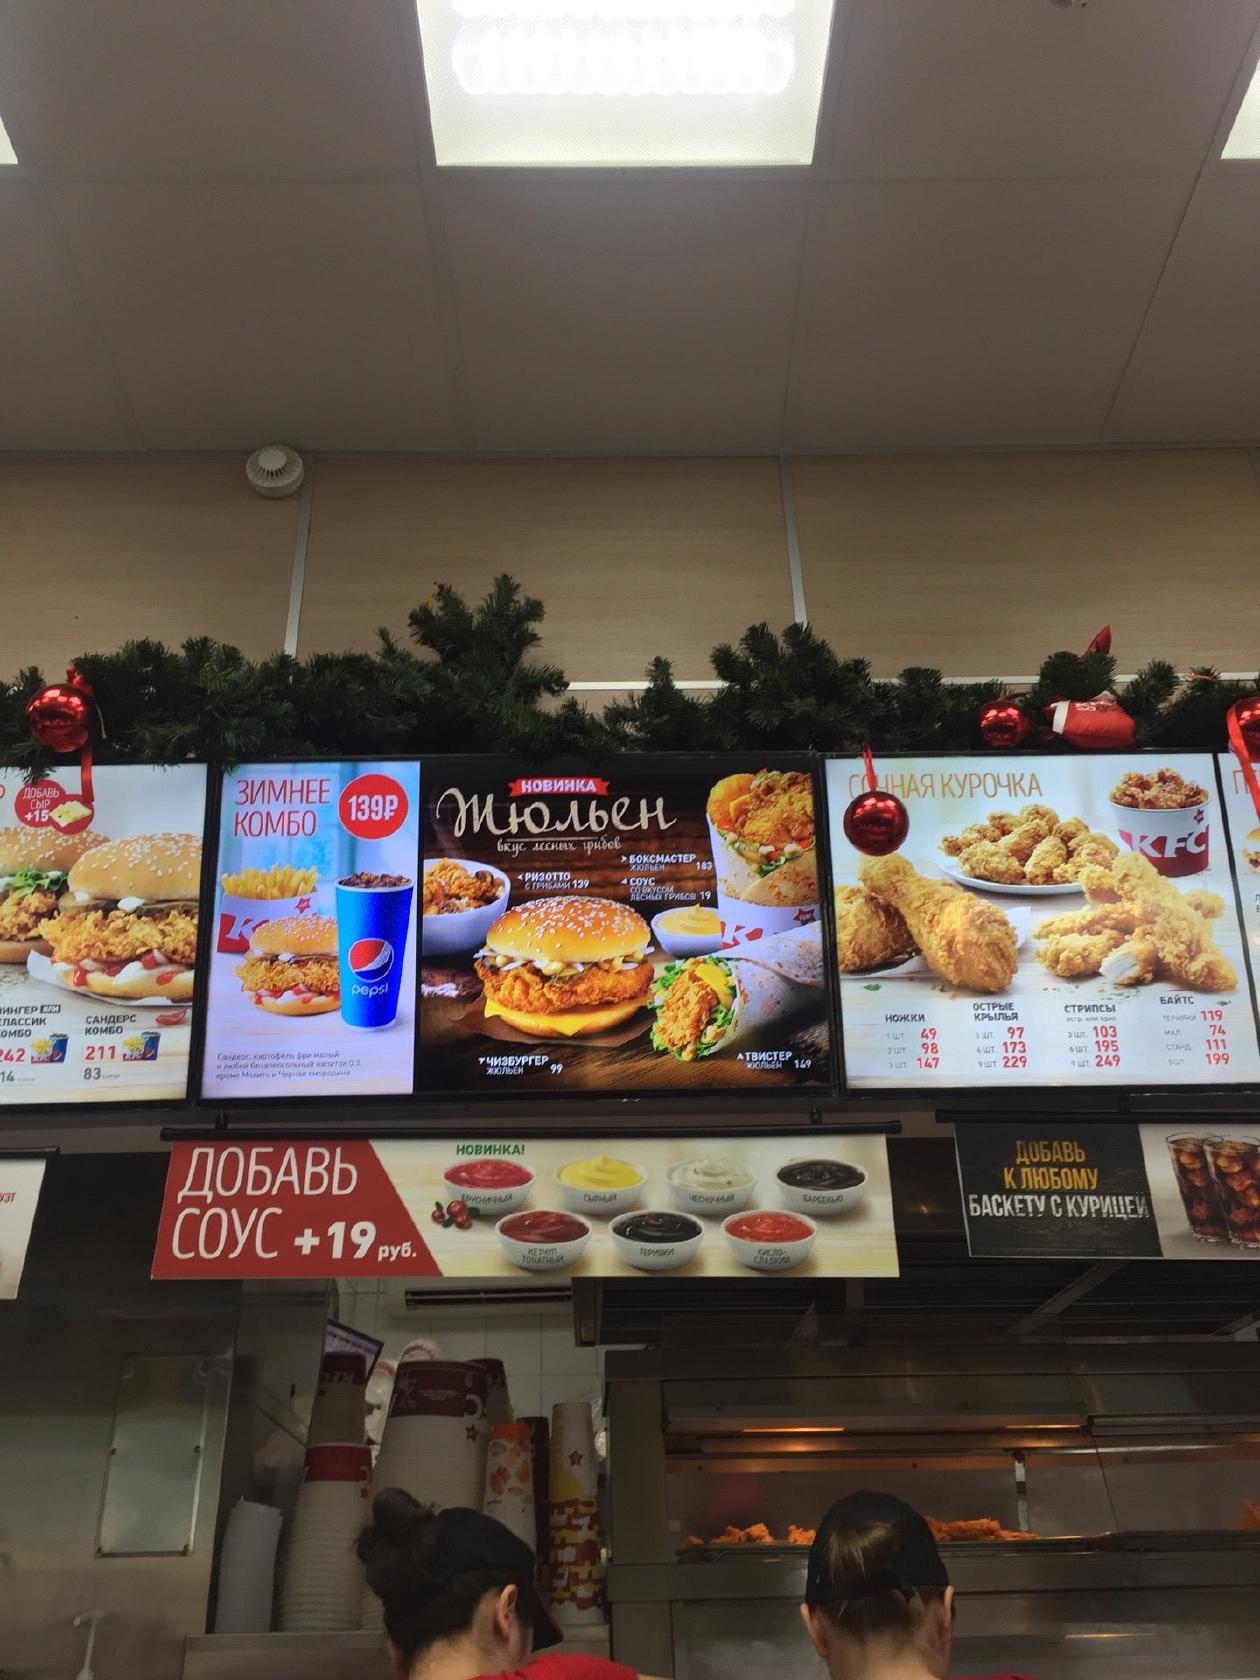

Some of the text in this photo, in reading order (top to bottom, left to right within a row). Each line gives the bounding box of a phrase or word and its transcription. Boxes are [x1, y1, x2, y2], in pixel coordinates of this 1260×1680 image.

[235, 779, 332, 804] ЗИМНЕЕ
[521, 780, 597, 794] НОВИНКА
[940, 773, 1042, 798] КУРОЧКА
[23, 787, 60, 800] ДОБАВЬ
[30, 800, 50, 810] СЫР
[25, 810, 49, 822] +15
[234, 810, 317, 837] КОМБО
[1131, 824, 1209, 858] KFC
[497, 838, 526, 857] вкус
[532, 842, 576, 851] лесных
[629, 854, 696, 863] БОКСМАСТЕР
[524, 872, 571, 881] РИЗОТТО
[630, 878, 656, 886] СОУС
[700, 892, 711, 900] 19
[352, 983, 388, 998] pepsi
[1160, 994, 1194, 1005] БАЙТС
[973, 1002, 1014, 1012] ОСТРЫЕ
[1064, 1004, 1116, 1013] СТРИПСЫ
[86, 1014, 136, 1024] САНДЕРС
[886, 1014, 925, 1022] НОЖКИ
[974, 1012, 1018, 1022] КРЫЛЬЯ
[1200, 1010, 1222, 1021] 119
[0, 1029, 32, 1038] ОМБО
[85, 1026, 123, 1035] КОМБО
[920, 1028, 937, 1040] 49
[1007, 1027, 1024, 1039] 97
[1092, 1026, 1118, 1038] 103
[1210, 1024, 1226, 1036] 74
[921, 1042, 939, 1054] 98
[1002, 1042, 1026, 1054] 173
[1094, 1040, 1118, 1052] 195
[1206, 1038, 1227, 1050] 111
[85, 1046, 116, 1060] 211
[744, 1052, 792, 1061] ТВИСТЕР
[1206, 1053, 1230, 1065] 199
[486, 1056, 563, 1074] ЧИЗБУРГЕР 99
[794, 1059, 812, 1068] 149
[916, 1058, 940, 1068] 147
[1002, 1056, 1027, 1068] 229
[1095, 1055, 1120, 1068] 249
[84, 1068, 101, 1080] 83
[486, 1066, 524, 1074] ЖЮЛЬЕН
[456, 1144, 526, 1156] НОВИНКА!
[1016, 1140, 1086, 1165] ДОБАВЬ
[178, 1147, 358, 1204] ДОБАВЬ
[1004, 1167, 1098, 1190] К ЛЮБОМУ
[968, 1192, 1150, 1220] БАСКЕТУ С КУРИЦЕЙ
[172, 1207, 417, 1262] СОУС +19 руб.
